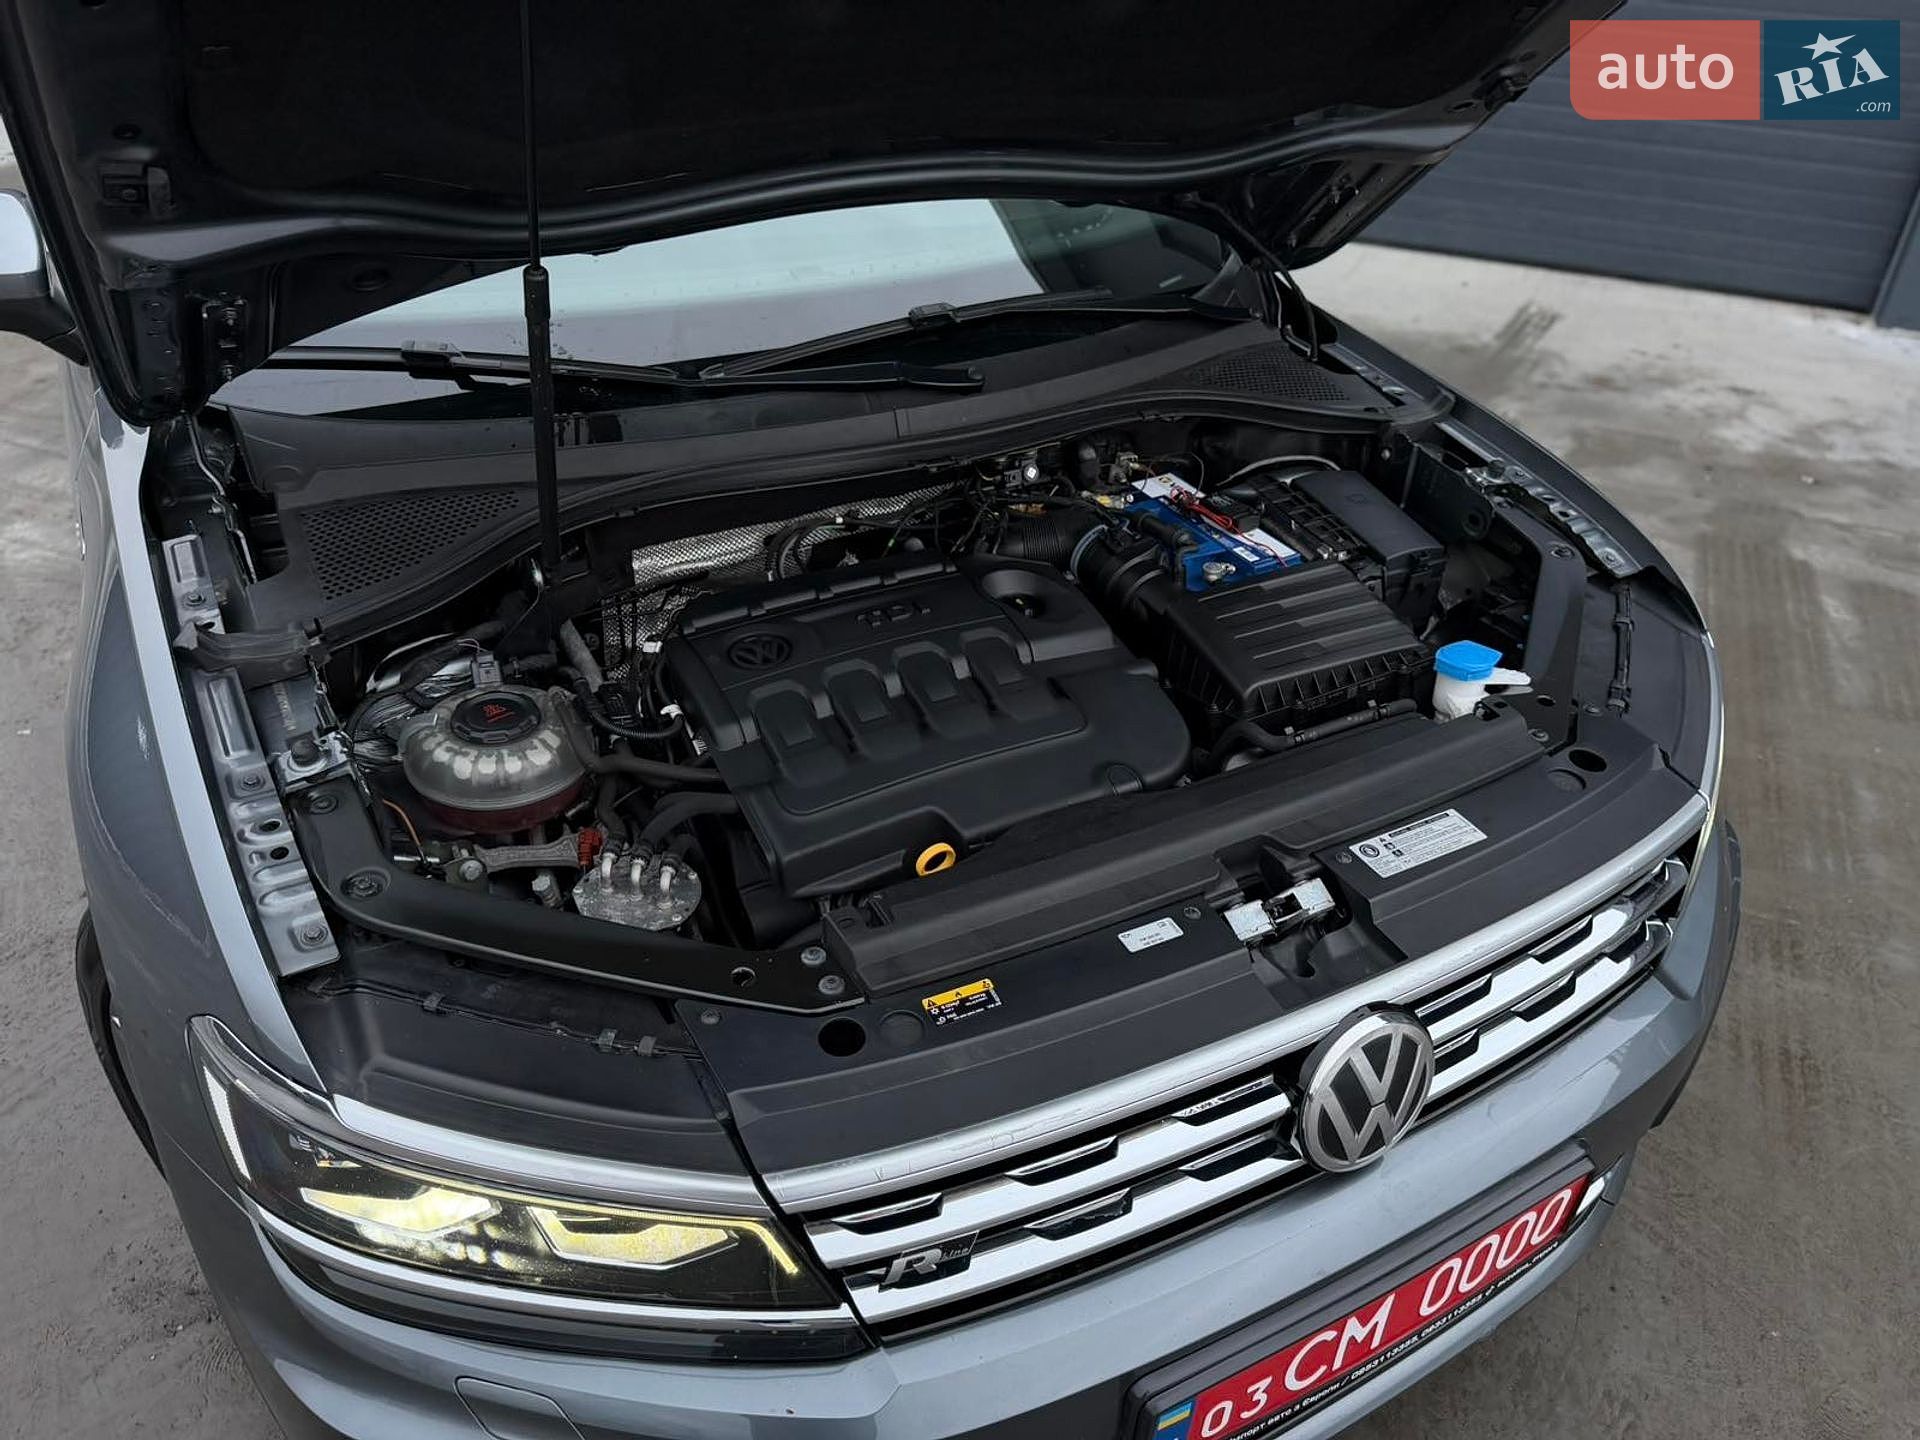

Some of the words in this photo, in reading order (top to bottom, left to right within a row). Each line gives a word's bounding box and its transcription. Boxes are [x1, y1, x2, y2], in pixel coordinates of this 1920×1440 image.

[1201, 1376, 1272, 1438] 03
[1284, 1292, 1396, 1391] CM
[1419, 1188, 1572, 1316] 0000
